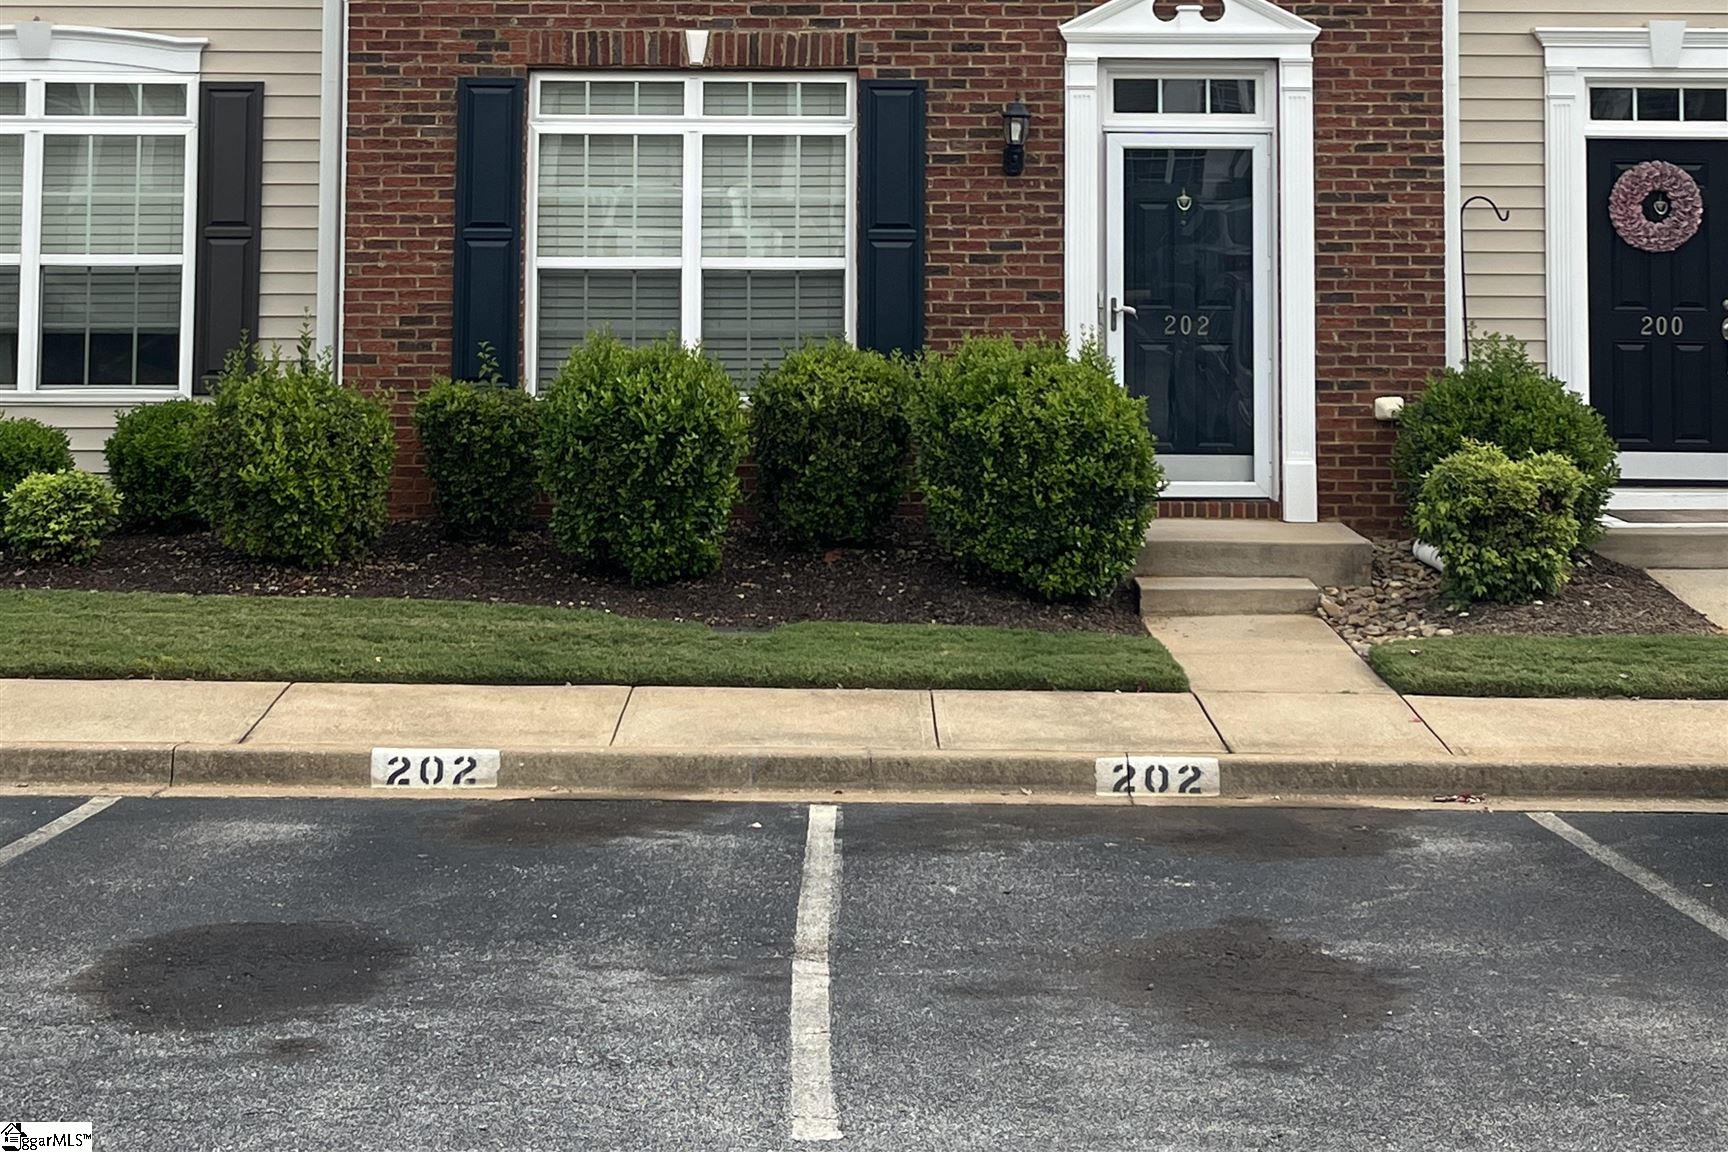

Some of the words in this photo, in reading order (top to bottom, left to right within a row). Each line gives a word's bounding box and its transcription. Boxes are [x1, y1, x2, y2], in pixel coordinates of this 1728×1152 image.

[1164, 314, 1210, 336] 202
[1640, 315, 1683, 336] 200
[386, 755, 477, 786] 202
[1112, 764, 1202, 794] 202
